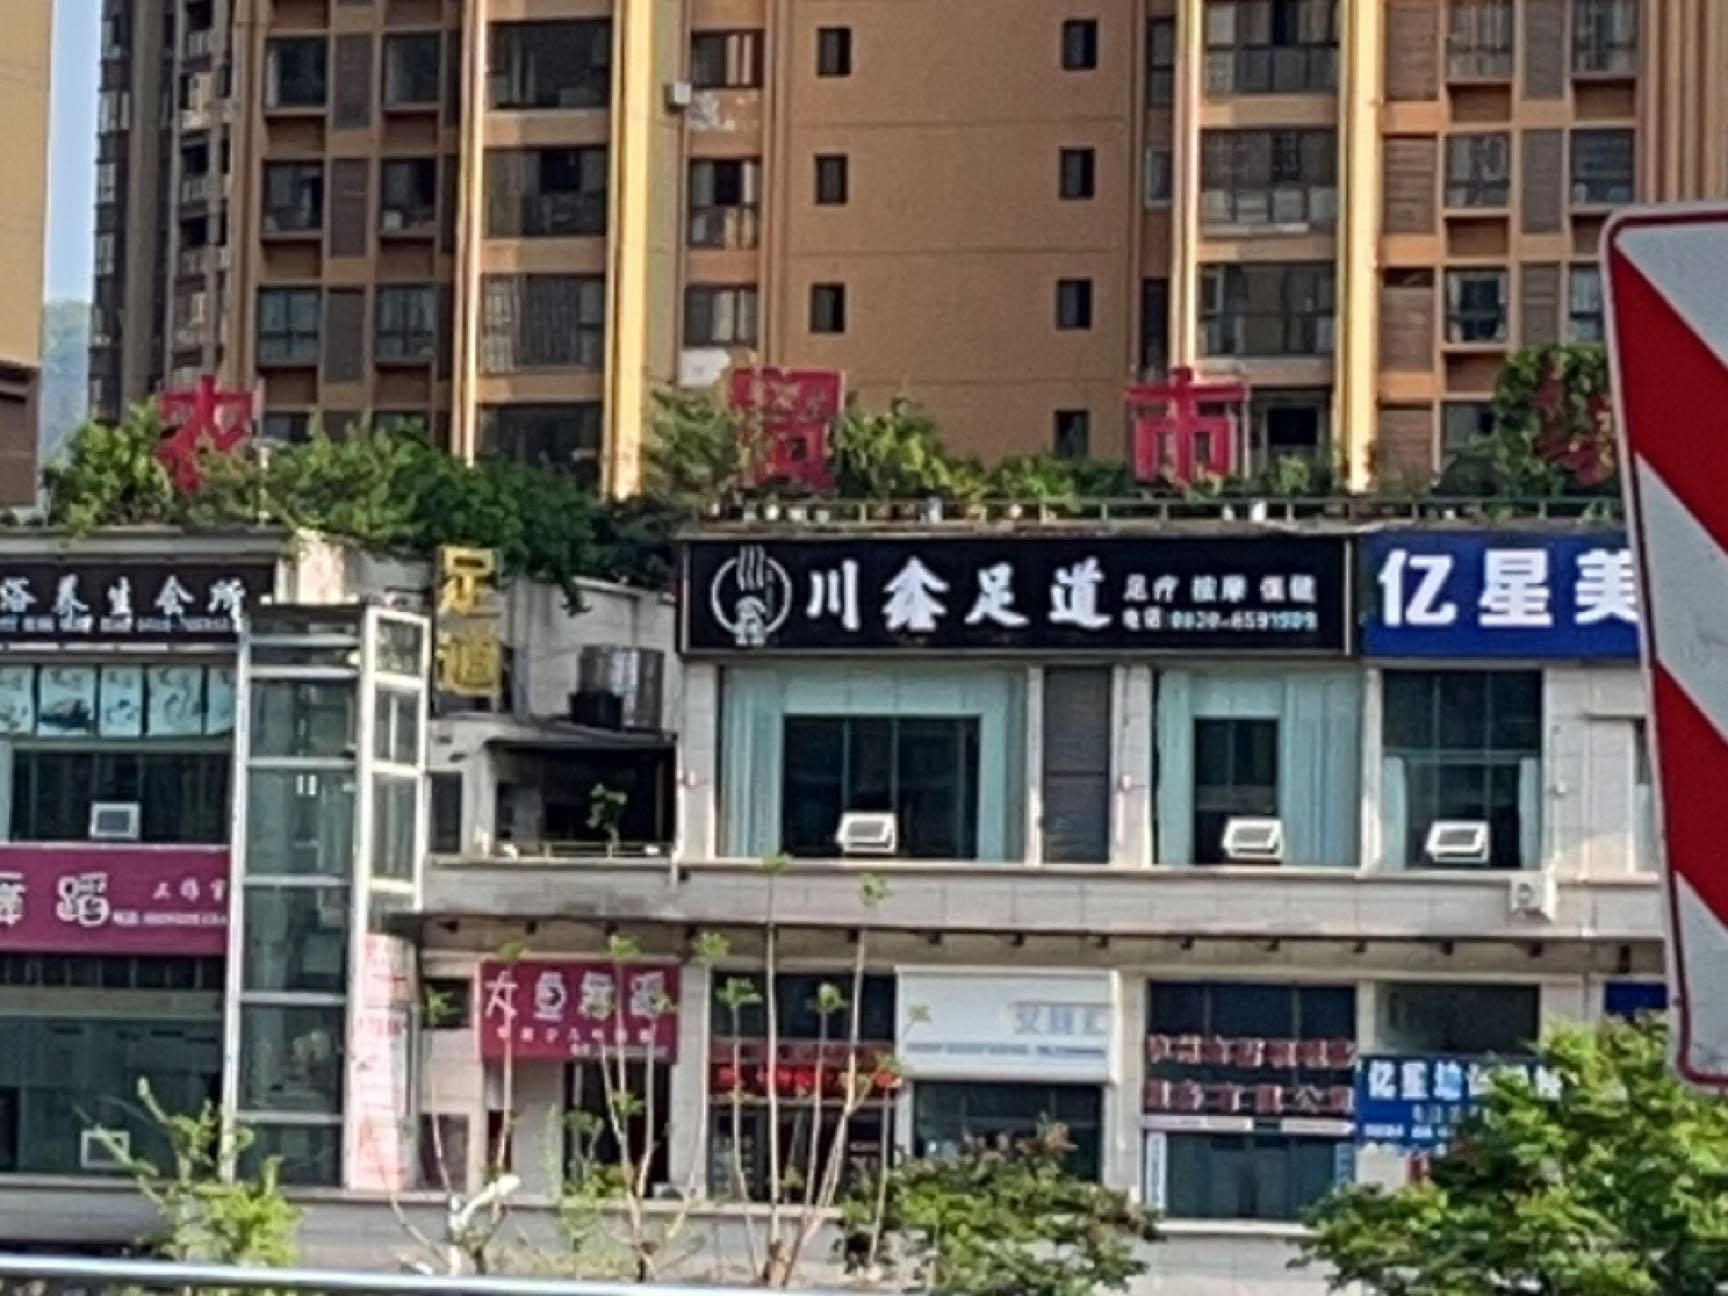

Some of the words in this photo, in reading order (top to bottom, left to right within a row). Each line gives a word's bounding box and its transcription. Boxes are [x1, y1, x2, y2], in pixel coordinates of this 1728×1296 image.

[807, 556, 1114, 631] 川鑫足道
[1377, 548, 1639, 627] 亿星美
